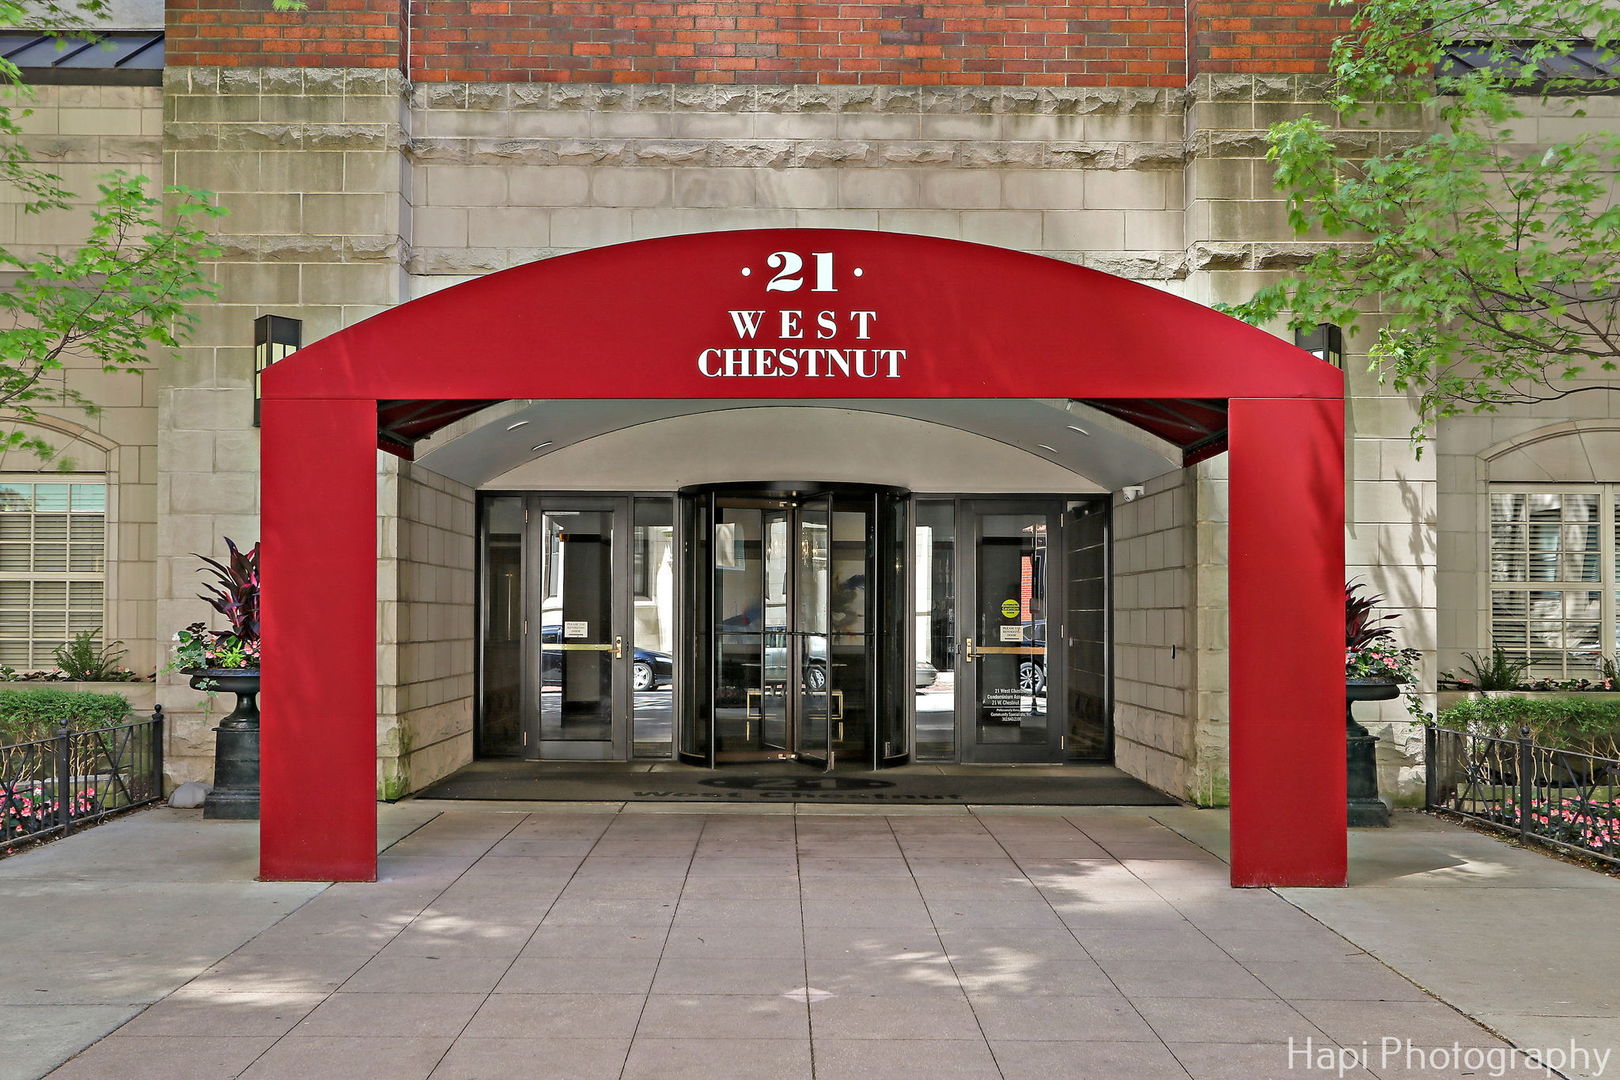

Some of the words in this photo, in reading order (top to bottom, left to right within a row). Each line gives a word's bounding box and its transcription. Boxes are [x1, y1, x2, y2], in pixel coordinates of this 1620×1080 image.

[766, 251, 838, 292] 21
[728, 310, 877, 340] WEST
[697, 348, 907, 378] CHESTNUT
